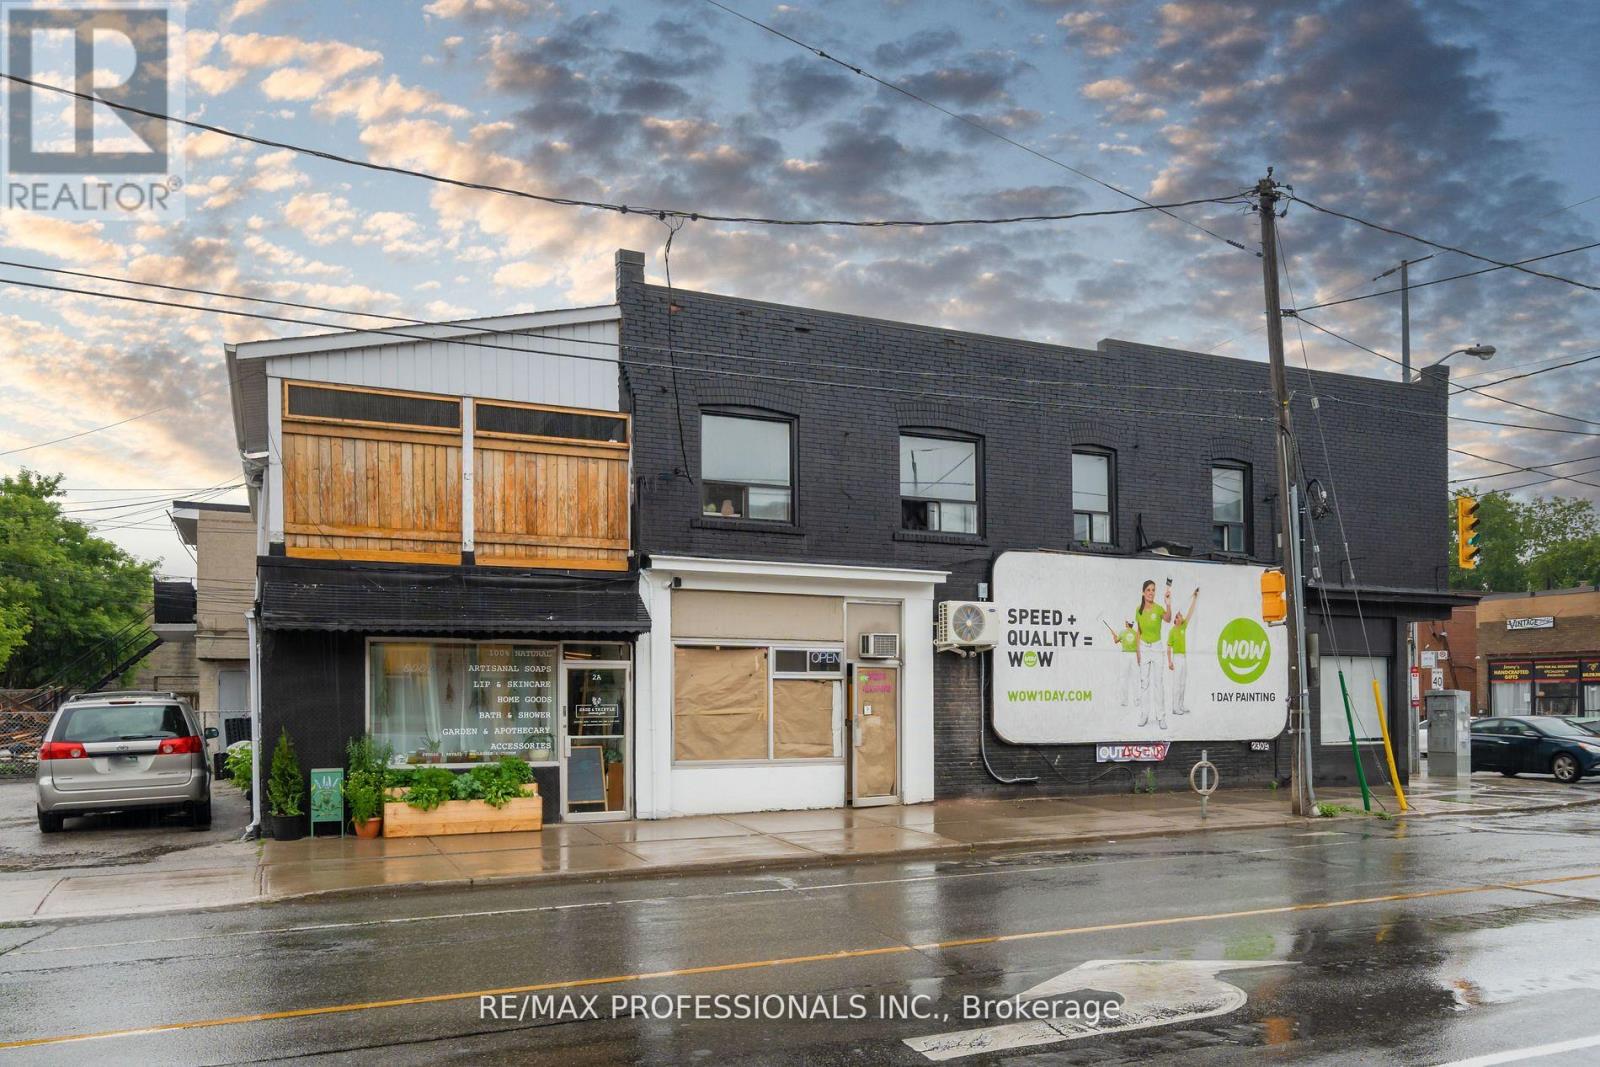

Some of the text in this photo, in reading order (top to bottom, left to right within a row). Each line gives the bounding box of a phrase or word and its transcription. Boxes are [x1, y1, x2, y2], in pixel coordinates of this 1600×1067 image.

[1008, 608, 1076, 625] SPEED +
[1509, 618, 1537, 628] VINTAGE
[1008, 630, 1092, 647] QUALITY =
[1221, 639, 1267, 660] WOW
[811, 652, 841, 663] OPEN
[1008, 651, 1053, 667] WOW
[524, 665, 552, 673] SOAPS
[1432, 677, 1443, 687] 40
[1008, 690, 1092, 702] WOW1DAY.COM
[1211, 692, 1276, 702] 1 DAY PAINTING
[490, 742, 552, 750] ACCESSORIES
